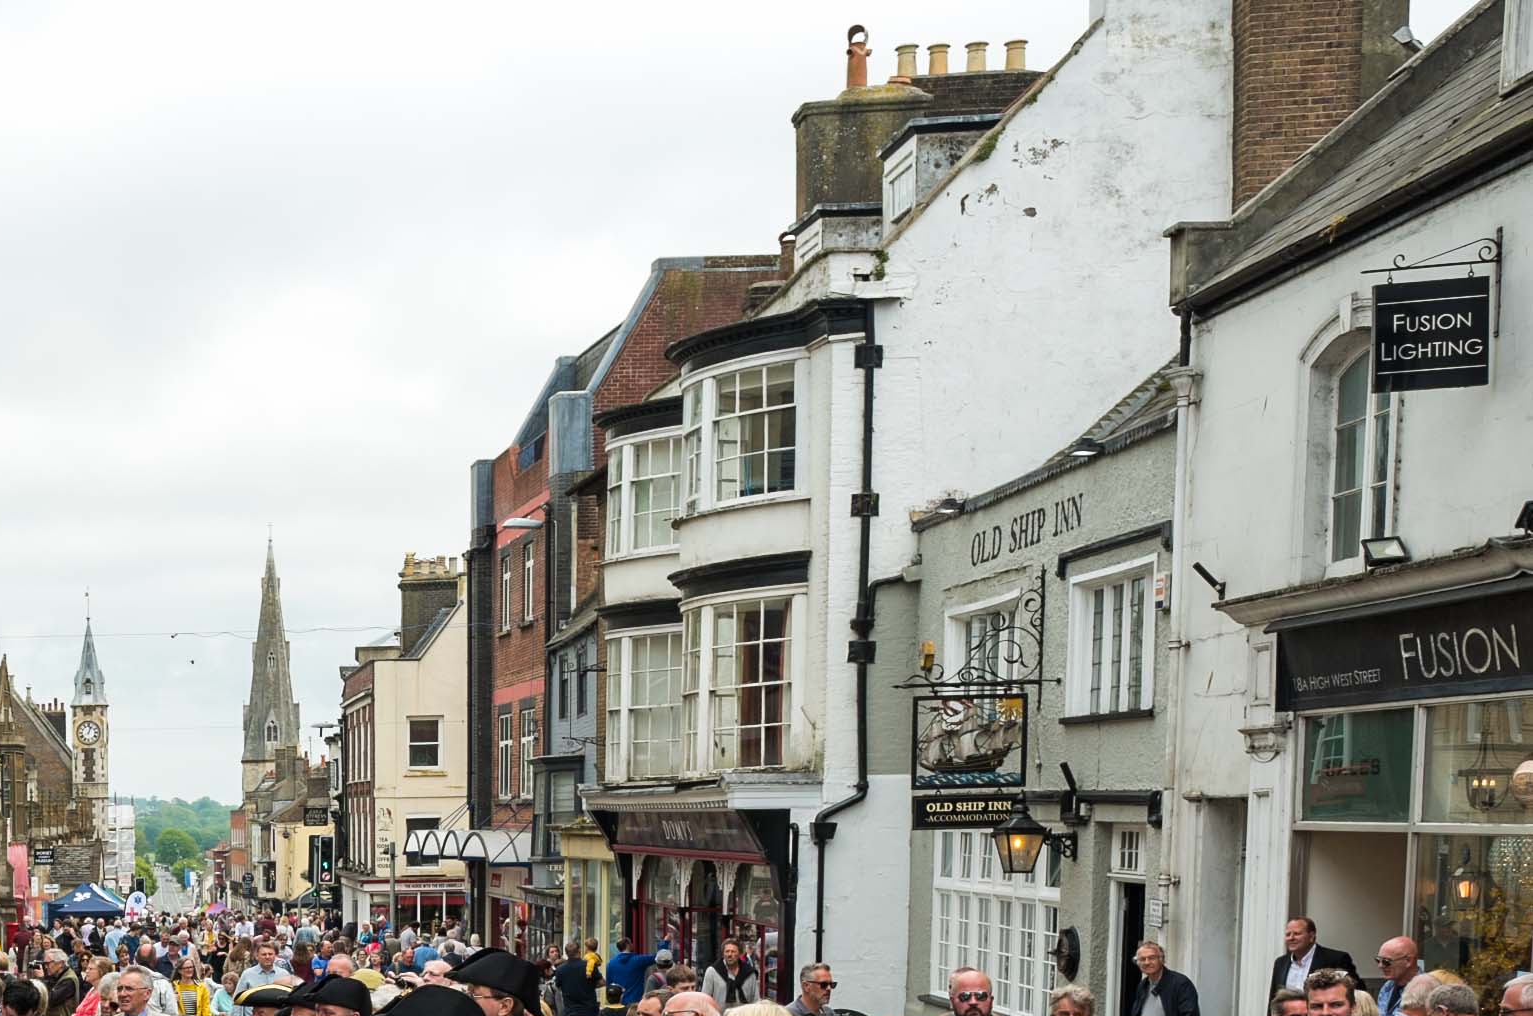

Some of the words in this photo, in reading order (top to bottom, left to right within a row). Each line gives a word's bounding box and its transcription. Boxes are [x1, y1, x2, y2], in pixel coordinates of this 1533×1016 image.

[1393, 312, 1472, 333] FUSION
[1381, 339, 1484, 361] LIGHTING
[971, 524, 1003, 567] OLD
[1008, 507, 1046, 554] SHIP
[1052, 492, 1084, 537] INN
[1398, 623, 1521, 680] FUSION
[1309, 675, 1331, 690] HIGH
[1331, 672, 1353, 687] WEST
[1354, 668, 1381, 685] STREET
[926, 802, 953, 812] OLD
[956, 801, 986, 811] SHIP
[988, 801, 1012, 810] INN
